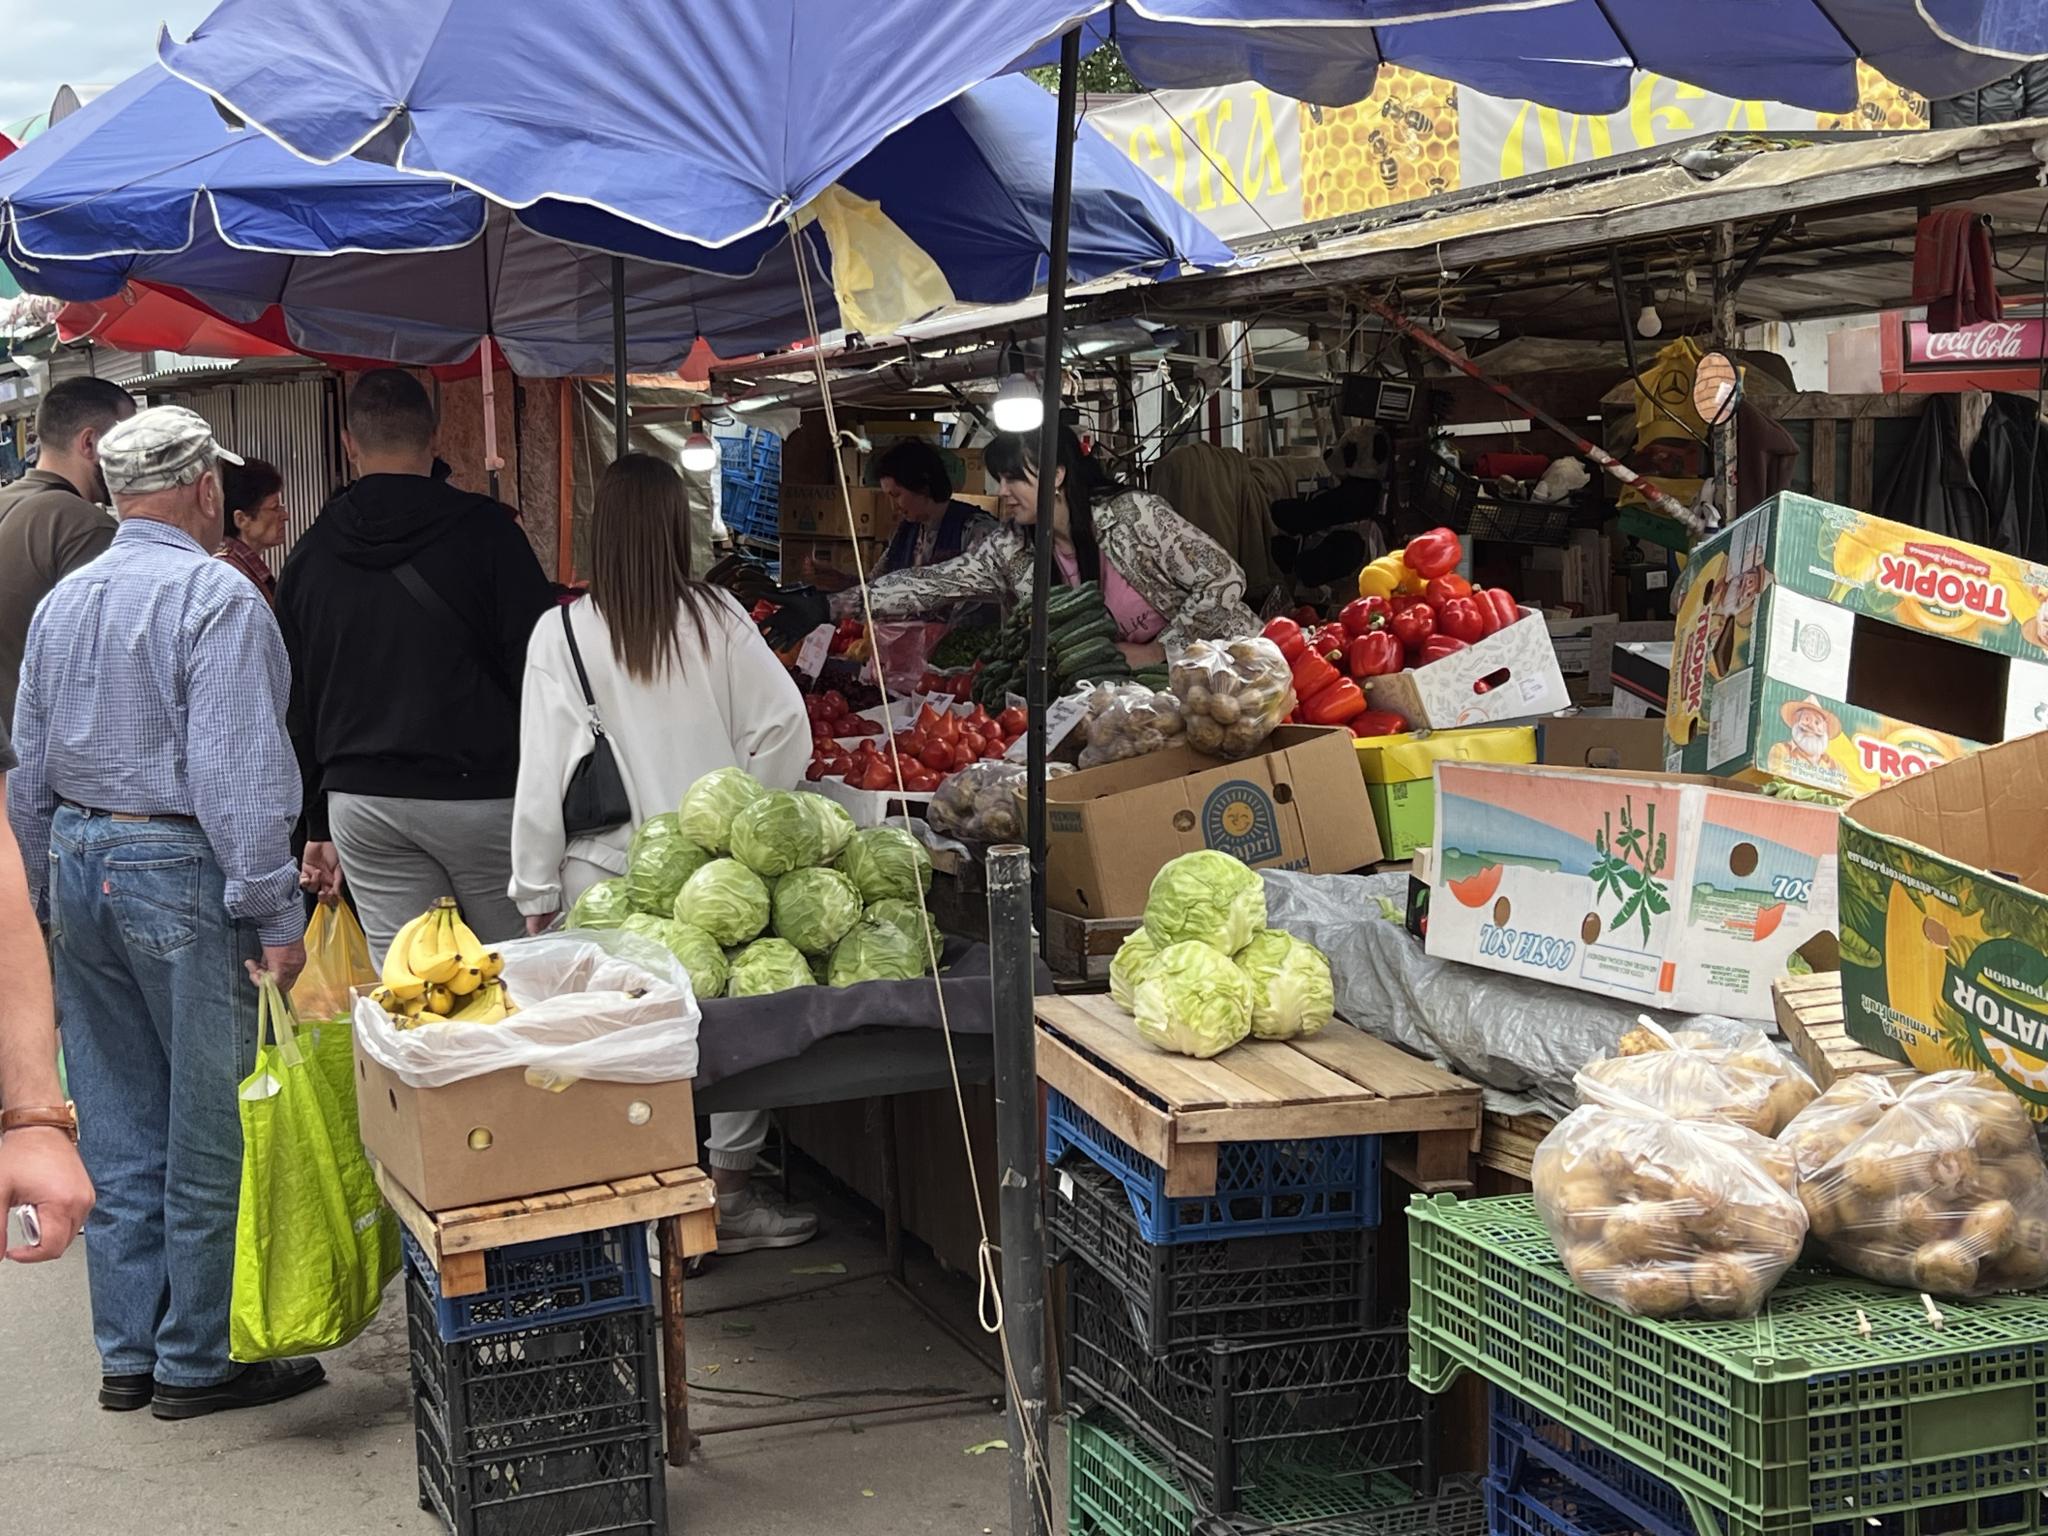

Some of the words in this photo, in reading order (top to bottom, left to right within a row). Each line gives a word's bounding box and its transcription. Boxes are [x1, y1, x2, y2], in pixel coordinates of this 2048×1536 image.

[1926, 322, 2027, 359] Coca-Cola
[1880, 557, 2007, 619] TROPIK
[1688, 610, 1710, 713] TROPIK
[1858, 740, 1943, 778] TRO
[1772, 874, 1814, 903] SOL
[1480, 923, 1518, 959] SOL
[1512, 931, 1576, 971] COSTA
[1861, 994, 1889, 1021] Fruit
[1882, 1019, 1918, 1048] EXTRA
[1887, 1007, 1941, 1046] Premium
